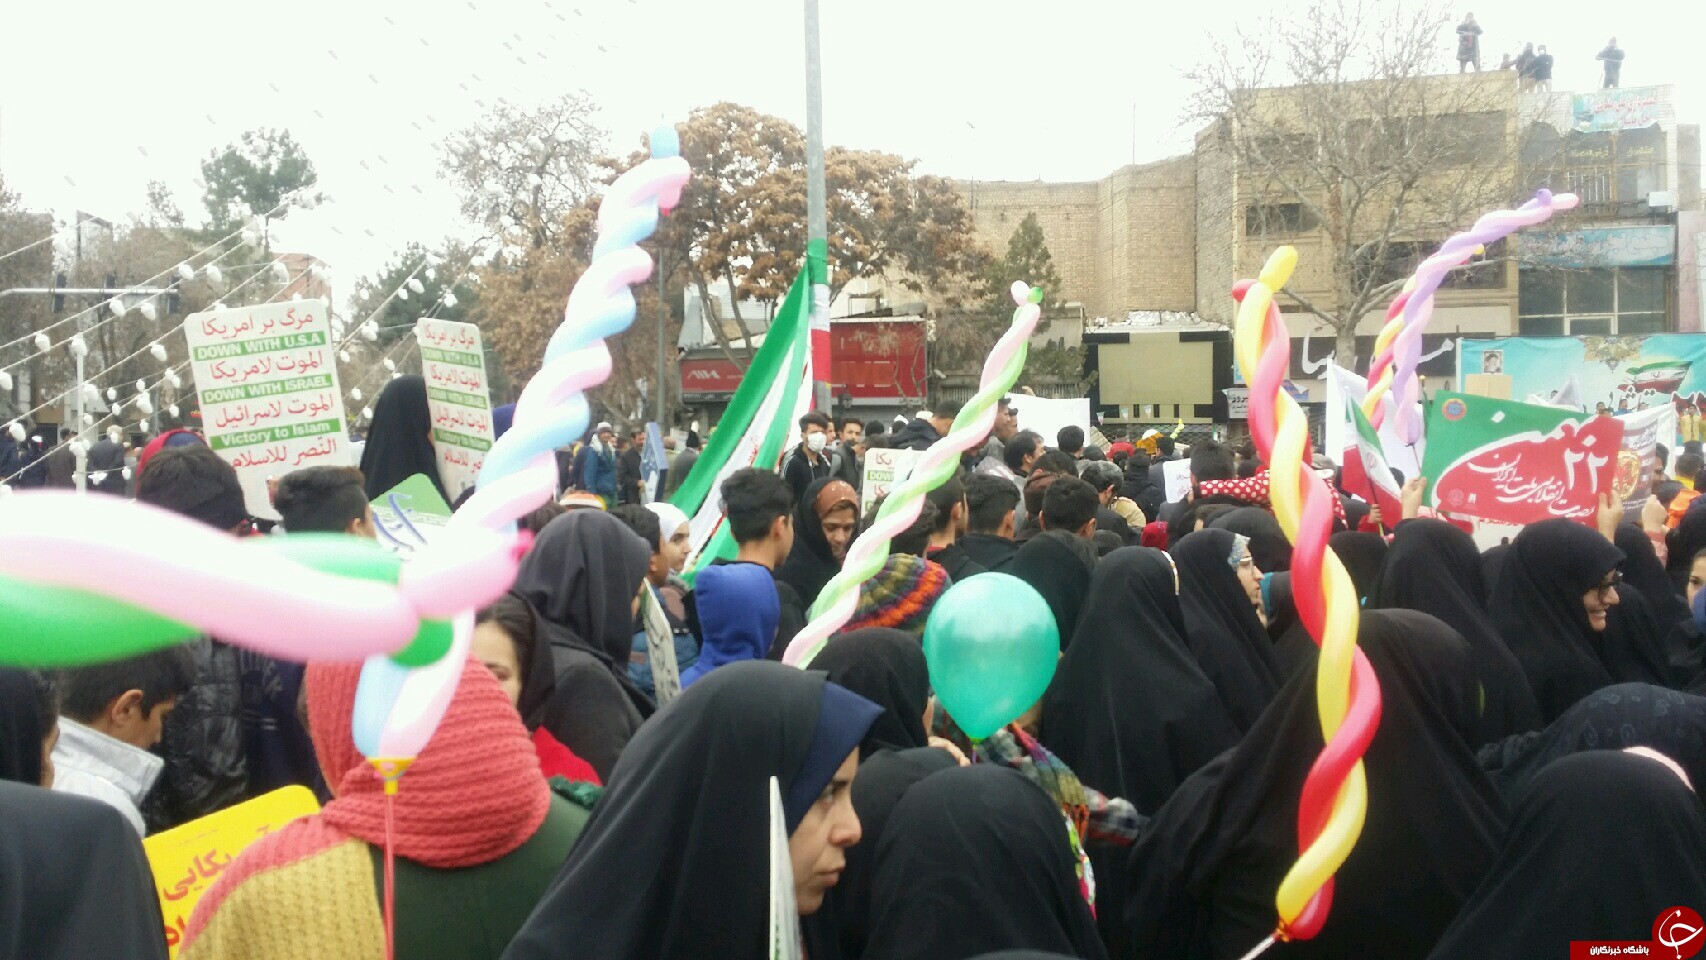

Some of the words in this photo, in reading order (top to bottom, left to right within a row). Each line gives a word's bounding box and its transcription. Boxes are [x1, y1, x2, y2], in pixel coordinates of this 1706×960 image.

[201, 315, 254, 340] امریکا
[260, 317, 274, 334] بر
[279, 307, 314, 329] مرگ
[197, 342, 241, 359] DOWN
[244, 338, 280, 355] WITH
[284, 332, 322, 348] U.S.A
[209, 356, 272, 383] لامریکا
[276, 350, 323, 374] الموت
[204, 387, 245, 403] DOWN
[249, 382, 281, 398] WITH
[285, 376, 331, 394] ISRAEL
[287, 393, 334, 417] الموت
[221, 430, 272, 448] Victory
[274, 426, 288, 439] to
[292, 421, 331, 437] Islam
[231, 445, 288, 468] للاسلام
[1432, 409, 1600, 511] بهمن
[1563, 447, 1609, 494] ۲۲
